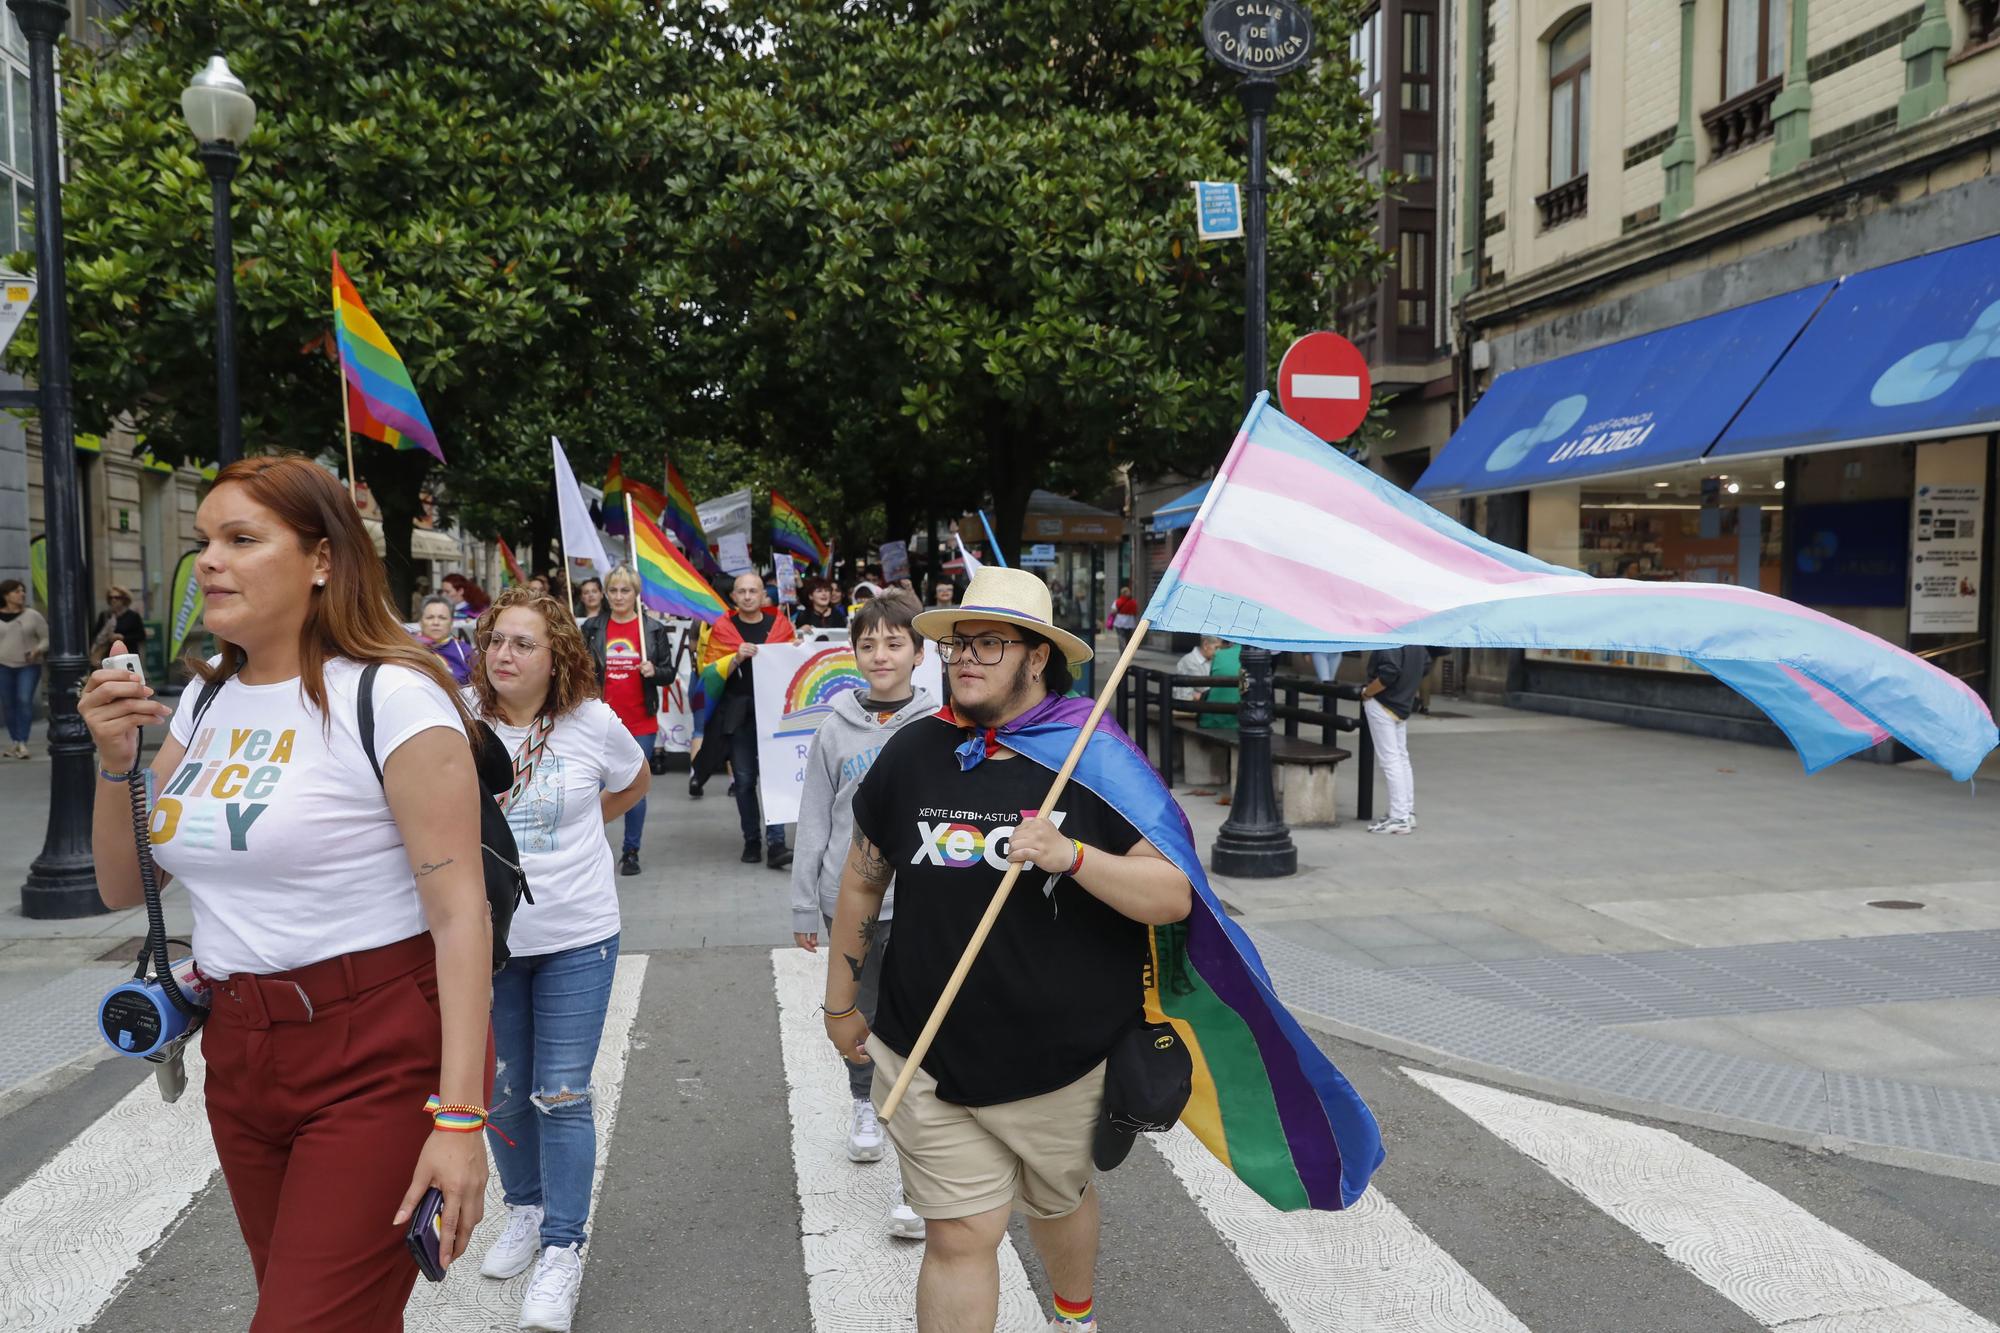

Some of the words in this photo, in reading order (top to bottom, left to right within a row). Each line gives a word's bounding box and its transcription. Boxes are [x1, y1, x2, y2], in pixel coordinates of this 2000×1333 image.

[1236, 3, 1283, 20] CALLE
[1250, 26, 1268, 39] DE
[1217, 31, 1303, 62] COVADONGA
[1547, 440, 1578, 464] LA
[918, 807, 949, 818] XENTE
[949, 810, 983, 821] LGTBI+
[983, 813, 1018, 822] ASTUR
